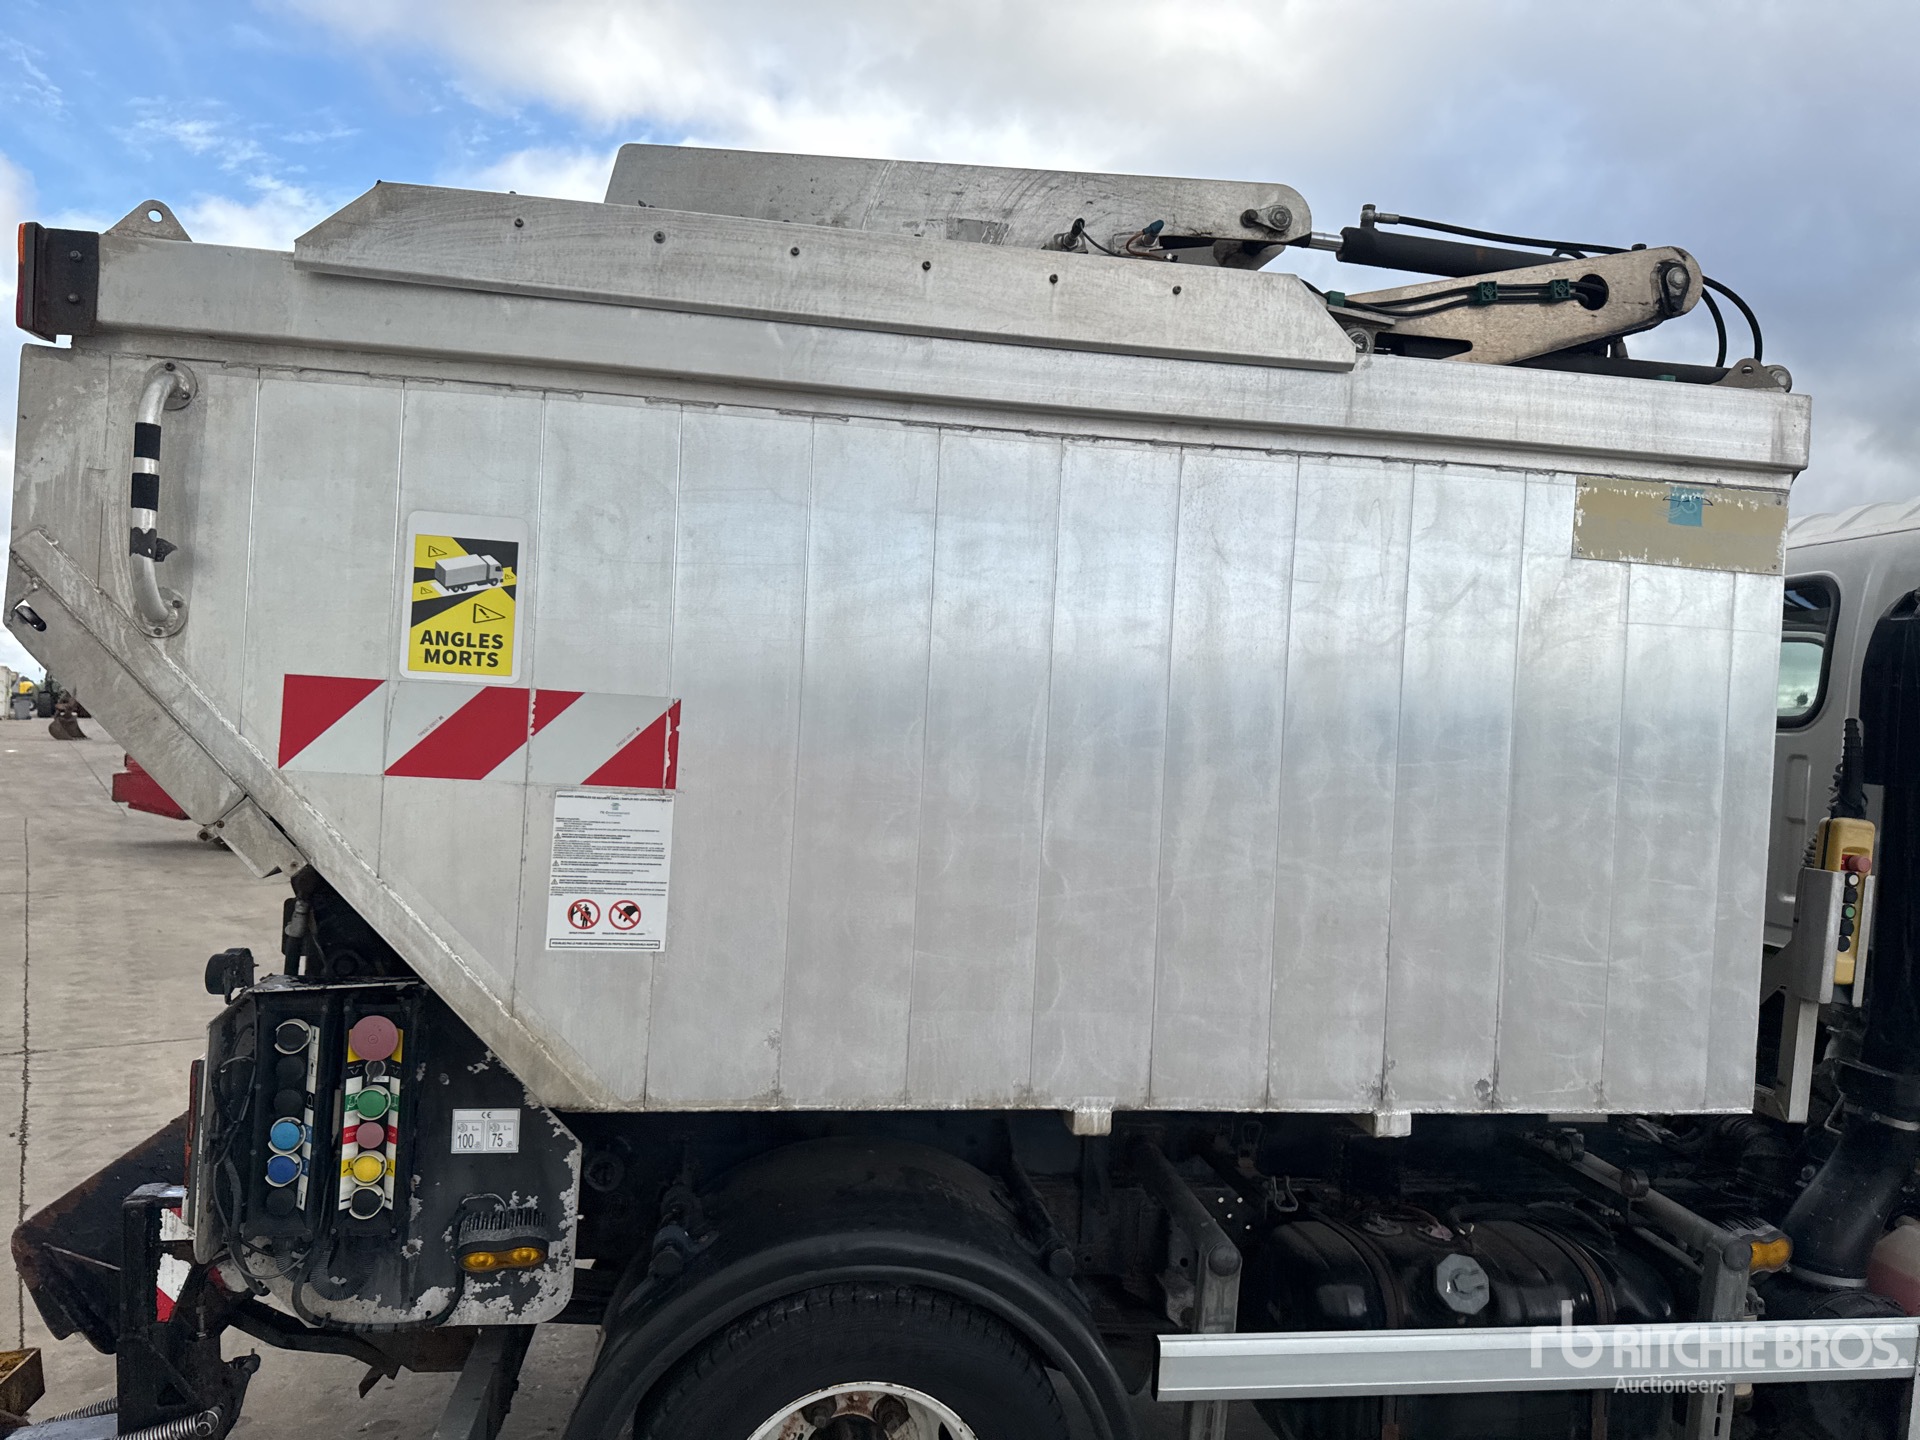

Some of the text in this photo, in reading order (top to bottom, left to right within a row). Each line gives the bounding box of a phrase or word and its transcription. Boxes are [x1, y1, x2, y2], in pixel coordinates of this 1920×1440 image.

[420, 630, 504, 650] ANGLES
[424, 648, 499, 668] MORTS
[457, 1133, 474, 1148] 100
[491, 1133, 503, 1147] 75
